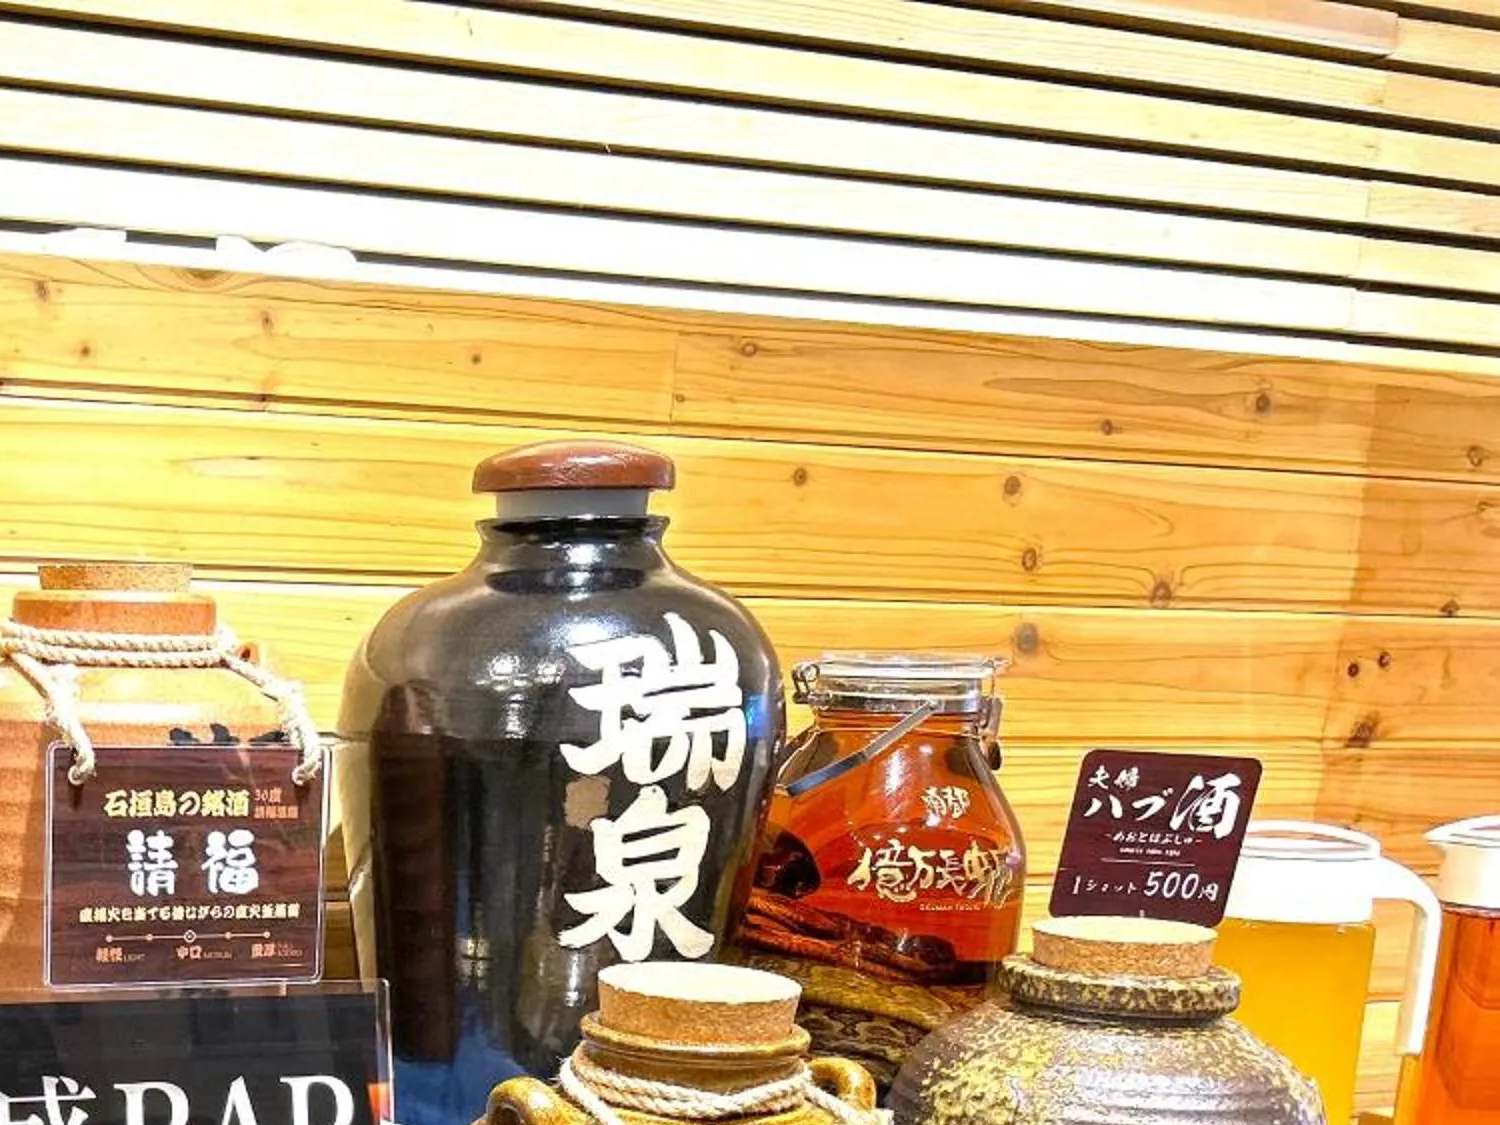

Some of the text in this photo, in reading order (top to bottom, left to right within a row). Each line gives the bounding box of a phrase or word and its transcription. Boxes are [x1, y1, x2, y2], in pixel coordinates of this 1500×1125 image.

[104, 789, 250, 818] 石垣島の銘酒
[557, 611, 747, 962] 瑞泉
[1083, 773, 1242, 839] ハブ酒
[126, 829, 259, 896] 請福
